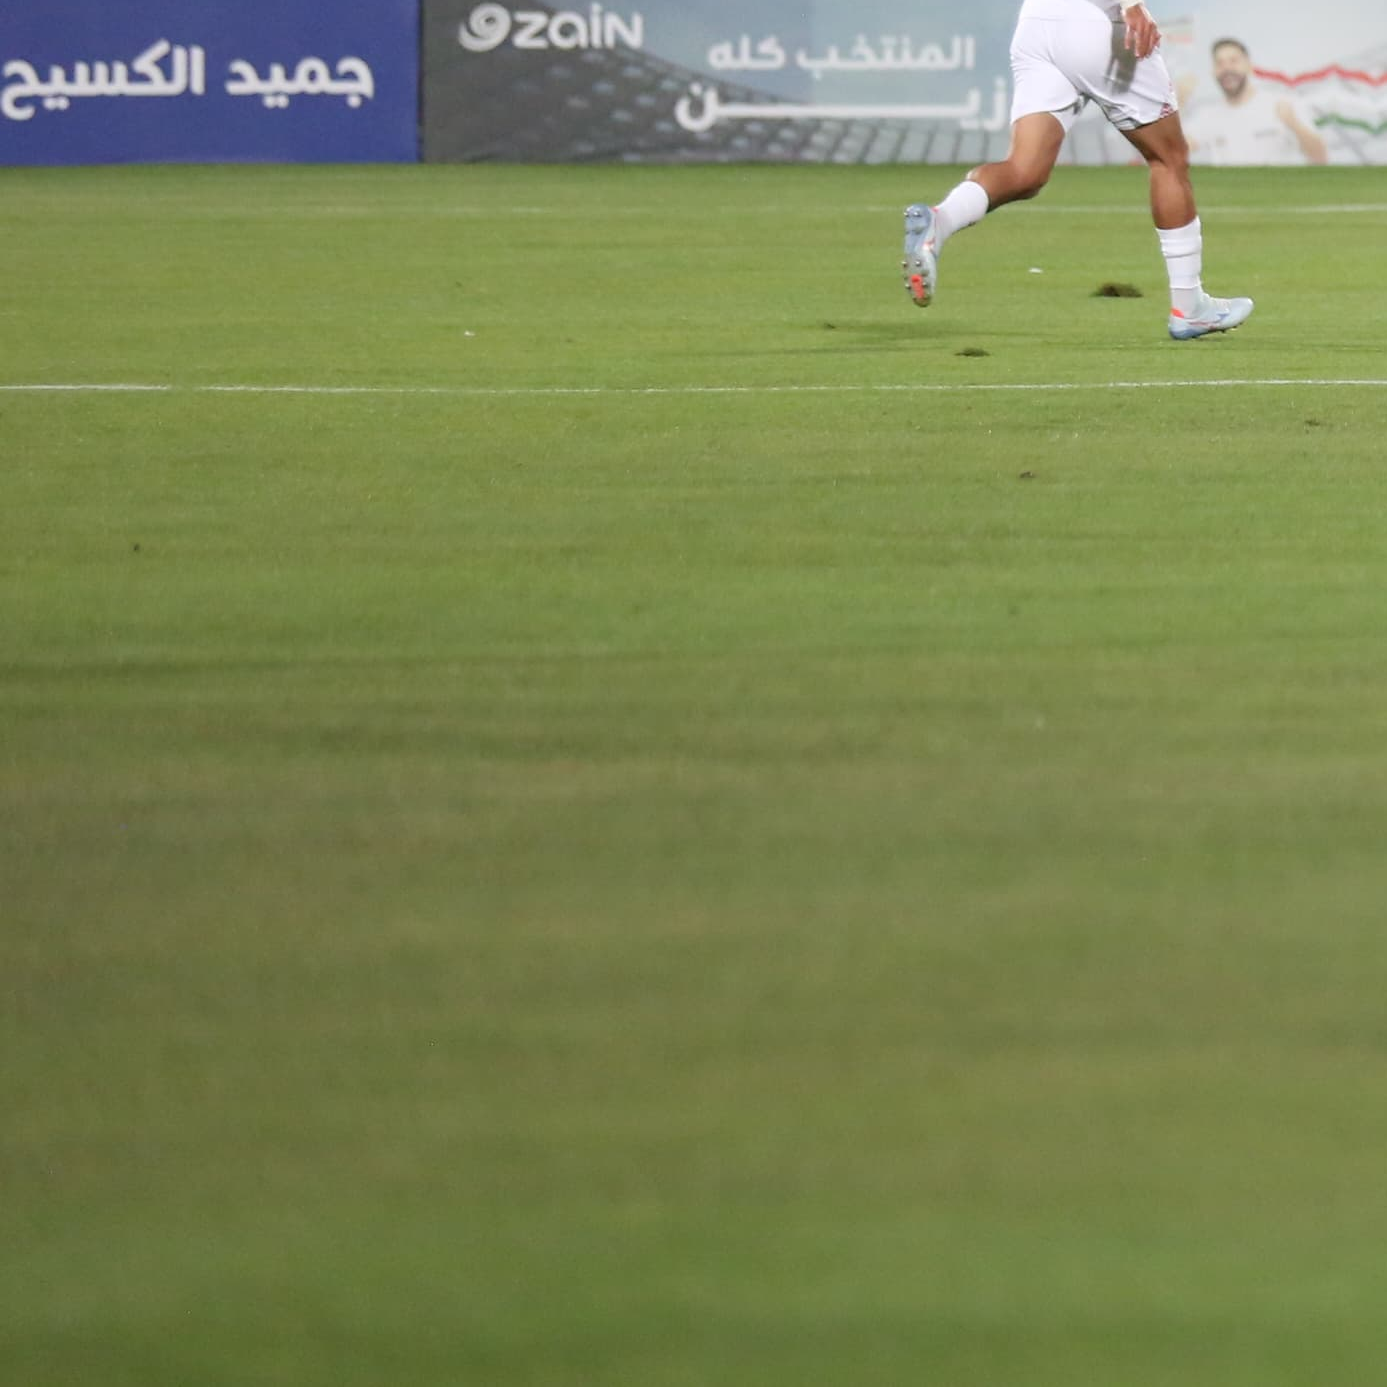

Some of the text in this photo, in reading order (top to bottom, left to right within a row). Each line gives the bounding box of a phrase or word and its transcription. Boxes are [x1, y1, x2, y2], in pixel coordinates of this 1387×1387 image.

[2, 39, 373, 120] جميد الكسيح
[707, 33, 976, 78] المنتخب كله
[674, 76, 1007, 132] زين
